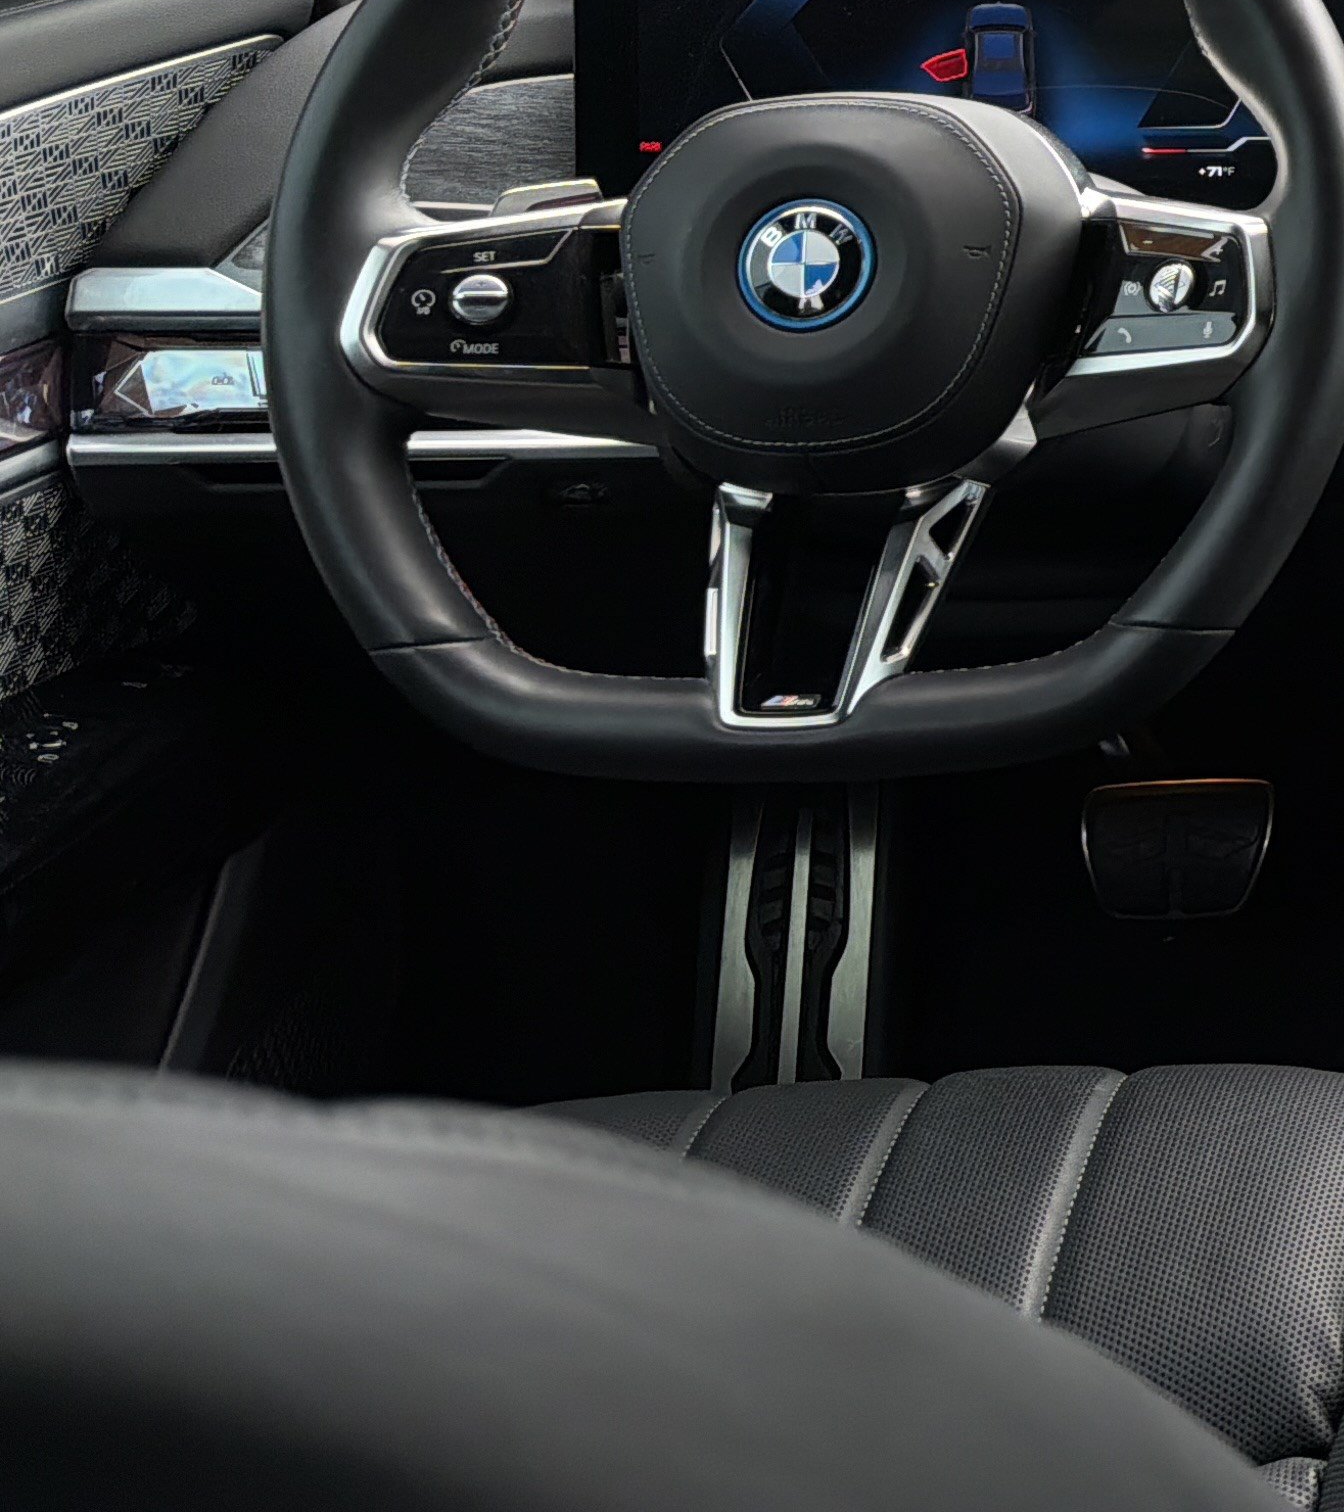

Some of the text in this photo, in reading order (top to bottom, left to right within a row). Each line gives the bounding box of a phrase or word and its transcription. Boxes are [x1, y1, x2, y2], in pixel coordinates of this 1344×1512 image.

[760, 212, 853, 248] BMW
[473, 250, 497, 262] SET
[462, 343, 500, 355] MODE
